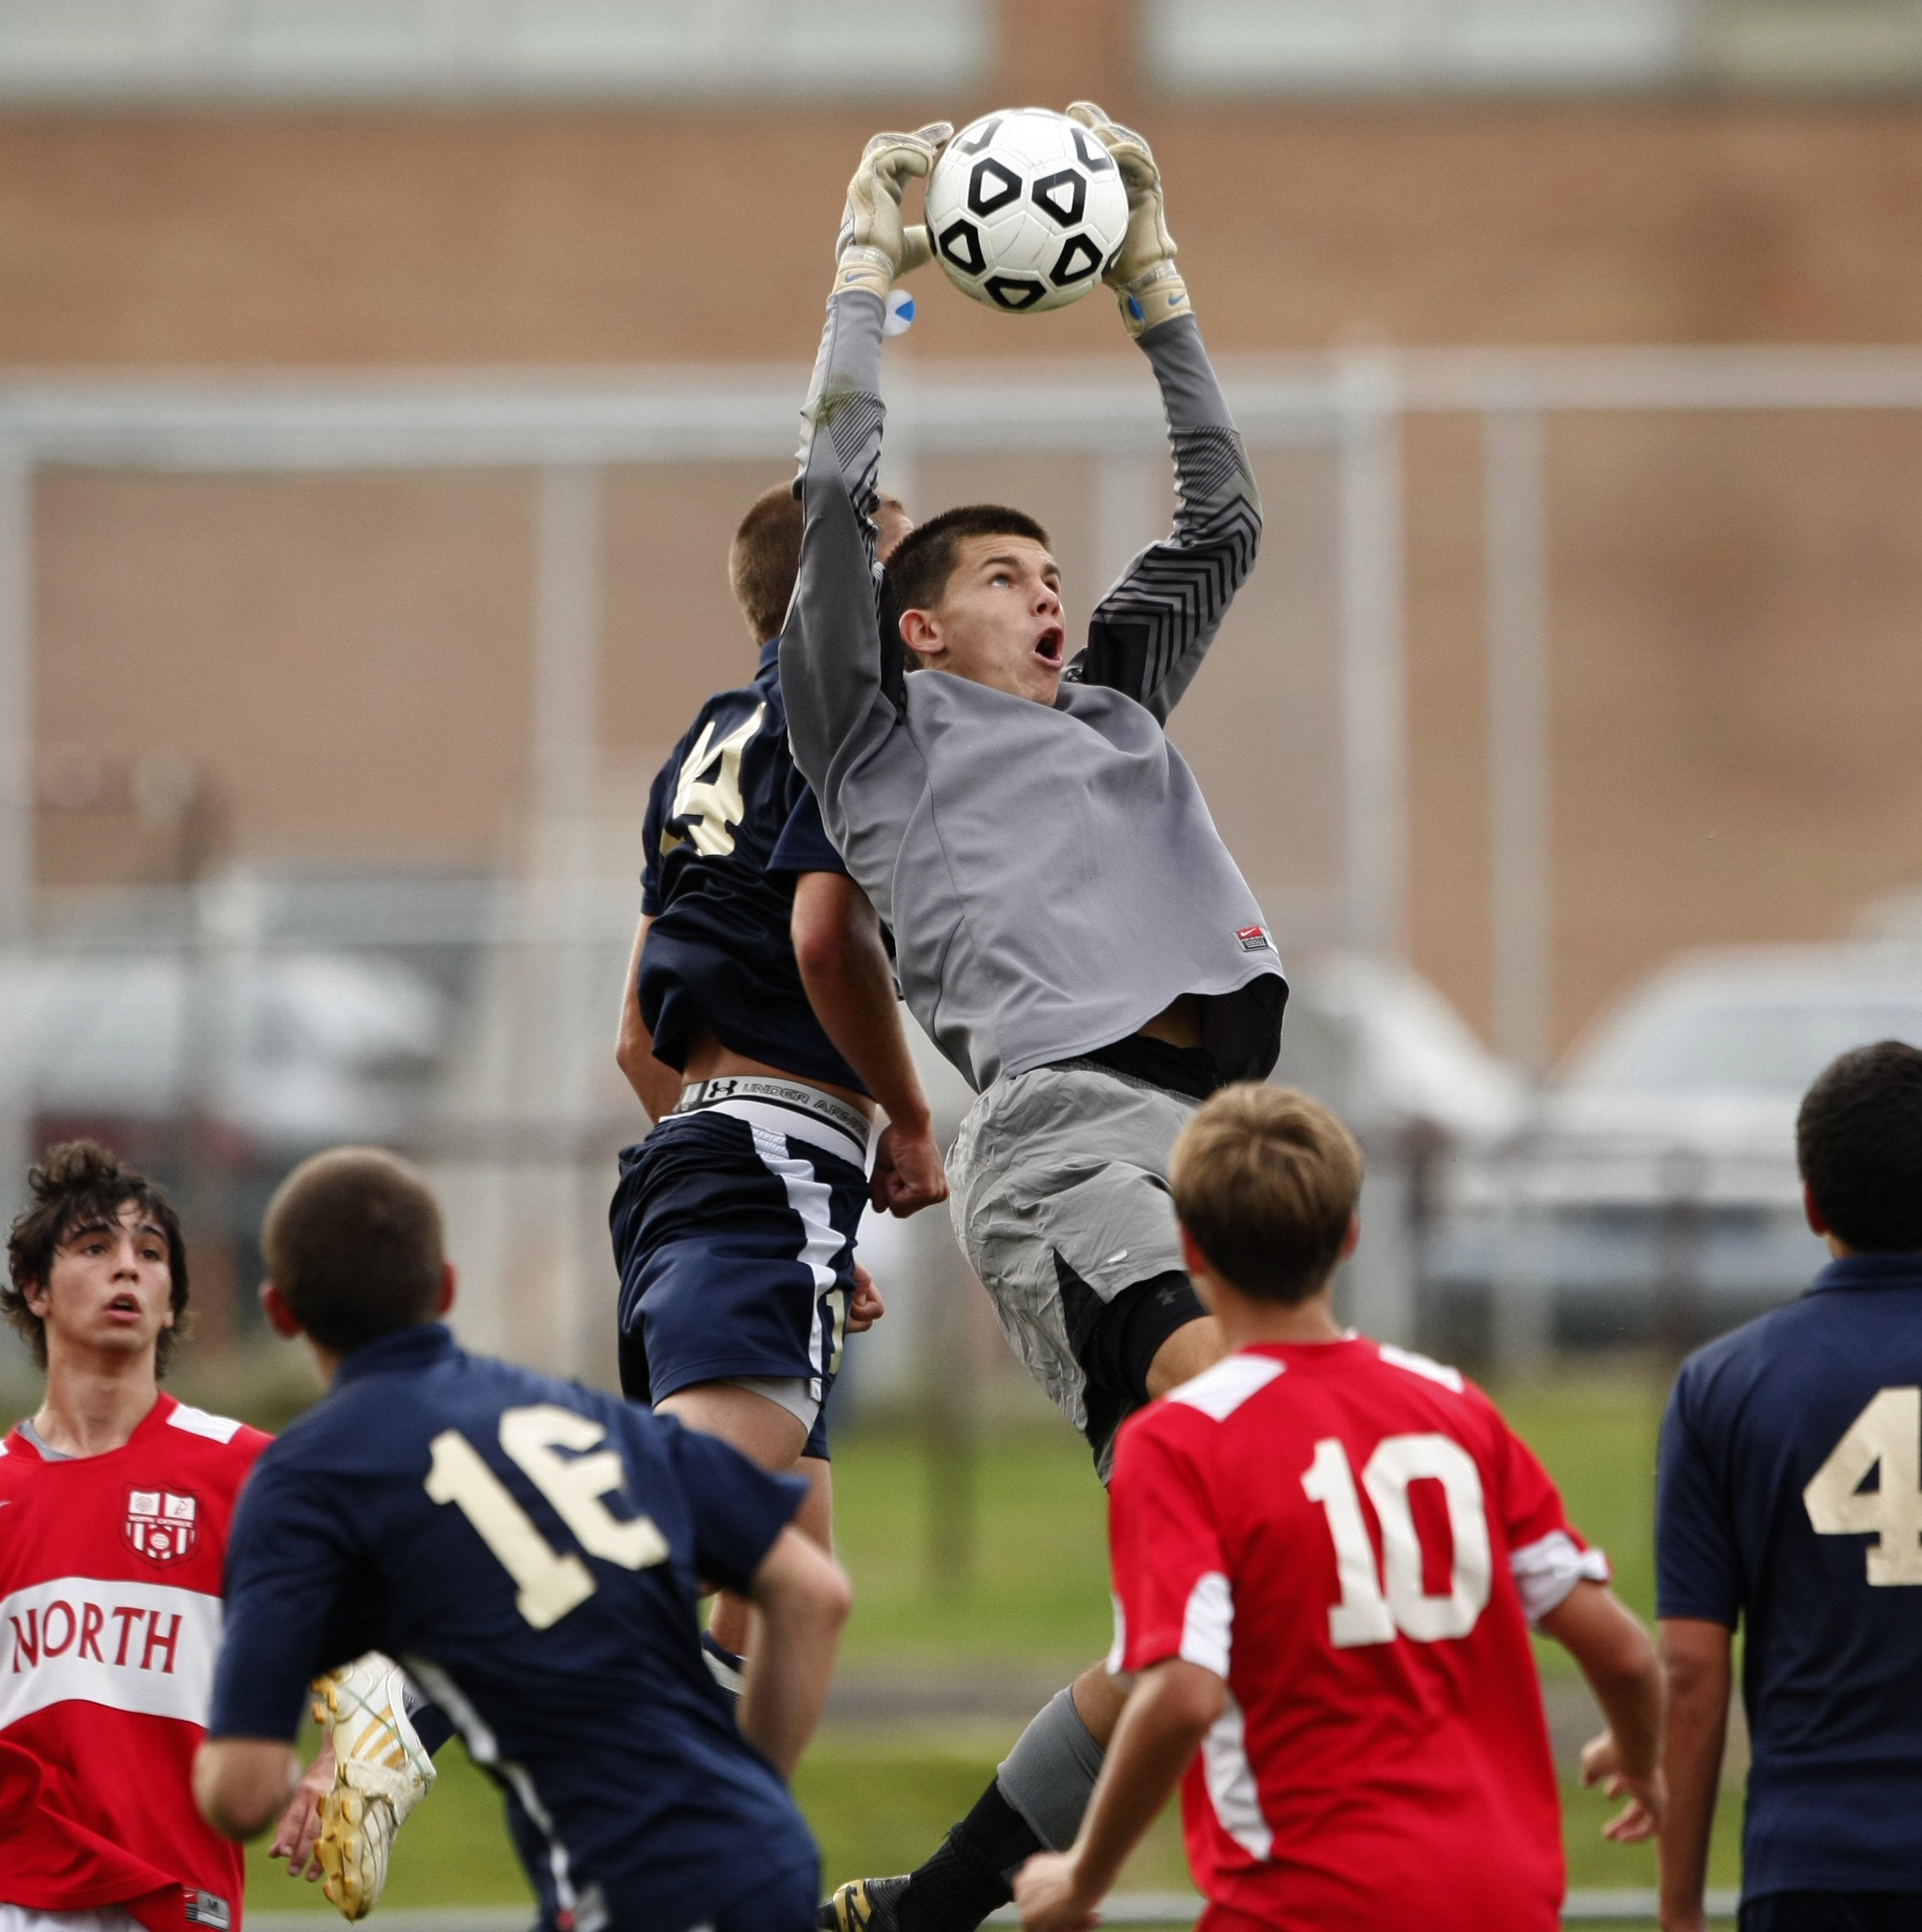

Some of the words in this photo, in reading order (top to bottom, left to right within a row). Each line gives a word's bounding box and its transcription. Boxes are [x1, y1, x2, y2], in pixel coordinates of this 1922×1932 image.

[742, 1083, 810, 1104] UNDER
[1300, 1433, 1493, 1648] 10
[1803, 1386, 1922, 1587] 4
[10, 1600, 183, 1675] NORTH
